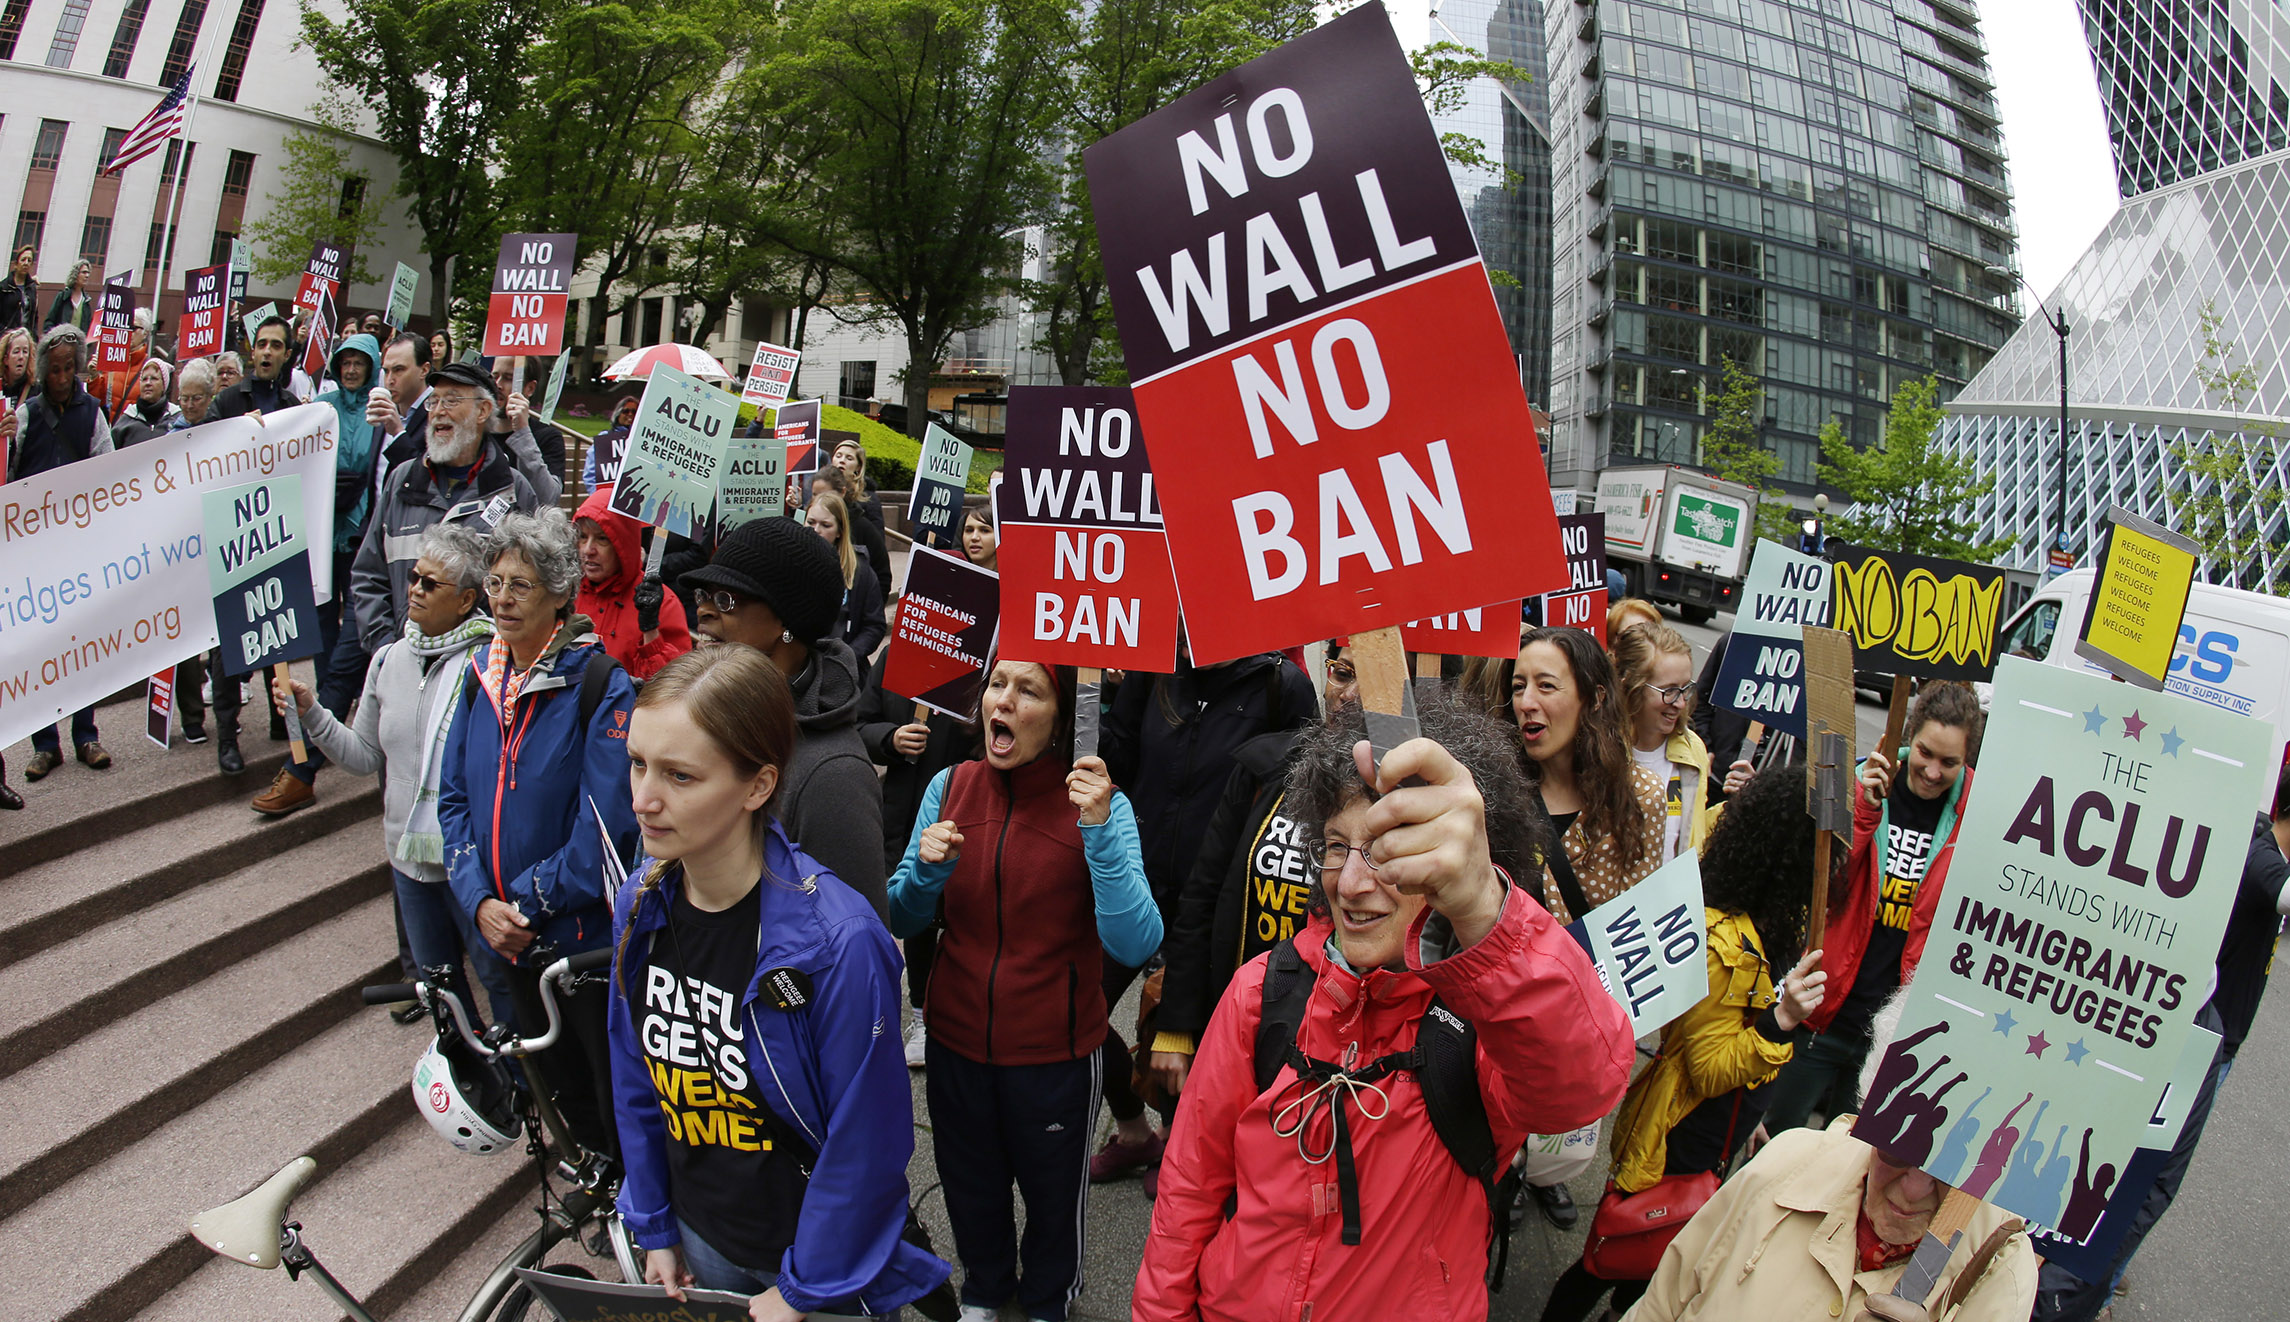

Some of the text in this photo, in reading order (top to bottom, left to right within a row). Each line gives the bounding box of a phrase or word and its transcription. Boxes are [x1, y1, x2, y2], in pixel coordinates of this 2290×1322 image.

[1176, 87, 1314, 217] NO
[234, 257, 248, 267] WALL
[238, 245, 246, 255] NO
[321, 248, 339, 263] NO
[520, 241, 553, 265] NO
[1136, 167, 1438, 354] WALL
[198, 275, 215, 293] NO
[234, 274, 243, 285] NO
[310, 260, 339, 280] WALL
[311, 276, 328, 291] NO
[502, 269, 562, 292] WALL
[108, 294, 121, 309] NO
[188, 292, 221, 312] WALL
[231, 286, 243, 298] BAN
[302, 290, 319, 306] BA
[511, 295, 544, 319] NO
[106, 311, 130, 328] WALL
[194, 311, 211, 329] NO
[254, 308, 266, 322] NO
[115, 330, 128, 345] NO
[188, 328, 214, 348] BAN
[500, 322, 548, 347] BAN
[107, 346, 126, 362] BAN
[761, 367, 782, 380] AND
[686, 394, 702, 408] THE
[1231, 318, 1391, 460] NO
[656, 396, 721, 437] ACLU
[778, 421, 809, 430] AMERICANS
[641, 426, 717, 468] IMMIGRANTS
[654, 418, 712, 450] STANDS WITH
[940, 438, 960, 457] NO
[1059, 407, 1132, 458] NO
[611, 438, 628, 459] N
[641, 441, 711, 479] & REFUGEES
[729, 460, 777, 475] ACLU
[929, 458, 962, 479] WALL
[5, 426, 334, 542] Refugees & Immigrants
[723, 487, 780, 496] IMMIGRANTS
[930, 486, 951, 507] NO
[1020, 467, 1163, 523] WALL
[234, 485, 271, 528] NO
[733, 496, 778, 504] REFUGEES
[920, 506, 951, 528] BAN
[1231, 438, 1474, 602] BAN
[219, 514, 295, 574] WALL
[1562, 526, 1588, 556] NO
[2121, 540, 2161, 564] REFUGEES
[102, 543, 152, 589] not
[160, 532, 207, 567] wa
[1054, 530, 1126, 584] NO
[2118, 555, 2158, 580] WELCOME
[1566, 559, 1602, 591] ALL
[1781, 562, 1825, 593] NO
[2114, 571, 2153, 595] REFUGEES
[244, 576, 284, 622] NO
[903, 604, 927, 621] FOR
[906, 592, 977, 626] AMERICANS
[1565, 594, 1590, 625] NO
[1755, 593, 1828, 627] WALL
[1833, 556, 2003, 668] NO BAN
[2106, 601, 2145, 627] REFUGEES
[2110, 586, 2151, 612] WELCOME
[901, 616, 963, 648] REFUGEES
[1034, 591, 1141, 648] BAN
[2102, 616, 2142, 643] WELCOME
[241, 608, 299, 665] BAN
[899, 628, 984, 669] & IMMIGRANTS
[1755, 646, 1800, 678] NO
[1733, 678, 1801, 714] BAN
[2192, 687, 2230, 705] SUPPLY
[2232, 700, 2253, 713] INC.
[2102, 752, 2152, 794] THE
[1888, 824, 1933, 856] REF
[2004, 775, 2212, 898] ACLU
[1885, 847, 1927, 880] GEE
[1254, 876, 1310, 915] WE
[1998, 864, 2179, 950] STANDS WITH
[1653, 903, 1700, 968] NO
[1605, 904, 1665, 1021] WALL
[1952, 896, 2187, 1011] IMMIGRANTS
[772, 975, 798, 1007] WELCOME
[778, 970, 806, 1004] REFUGEES
[1950, 942, 2163, 1049] & REFUGEES
[646, 965, 744, 1042] REFU
